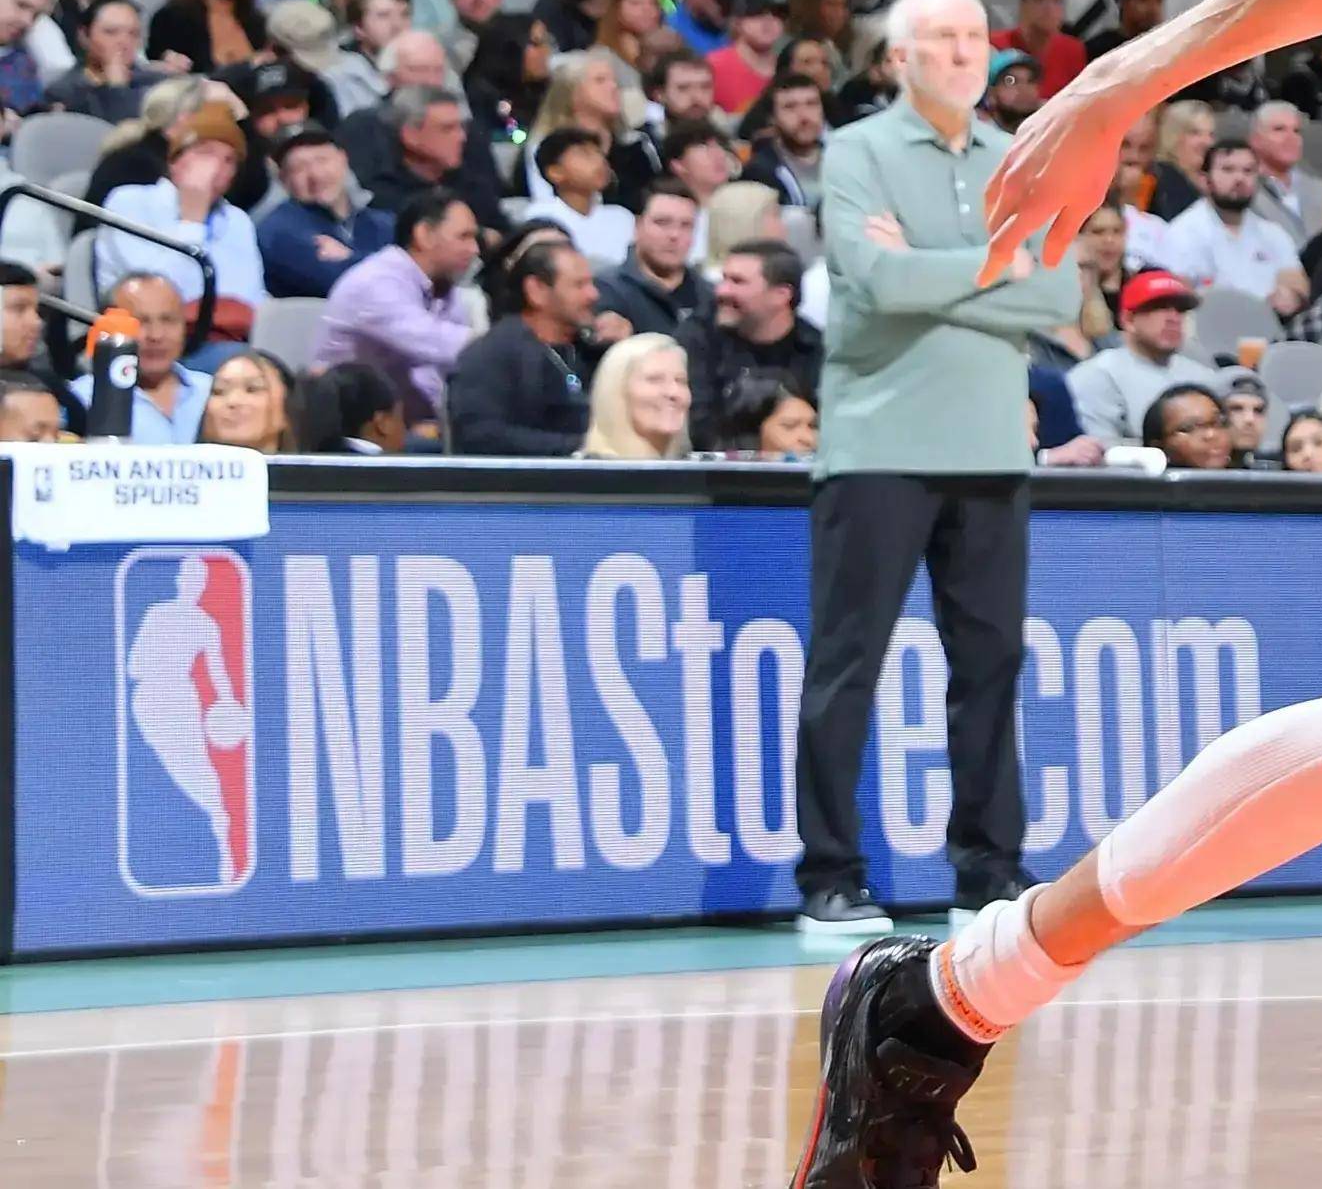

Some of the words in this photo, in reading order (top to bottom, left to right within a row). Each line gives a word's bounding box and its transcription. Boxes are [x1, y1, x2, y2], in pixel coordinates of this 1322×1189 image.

[68, 459, 120, 481] SAN
[128, 459, 246, 481] ANTONIO
[113, 484, 202, 506] SPURS
[282, 552, 1263, 882] NBAStoecom
